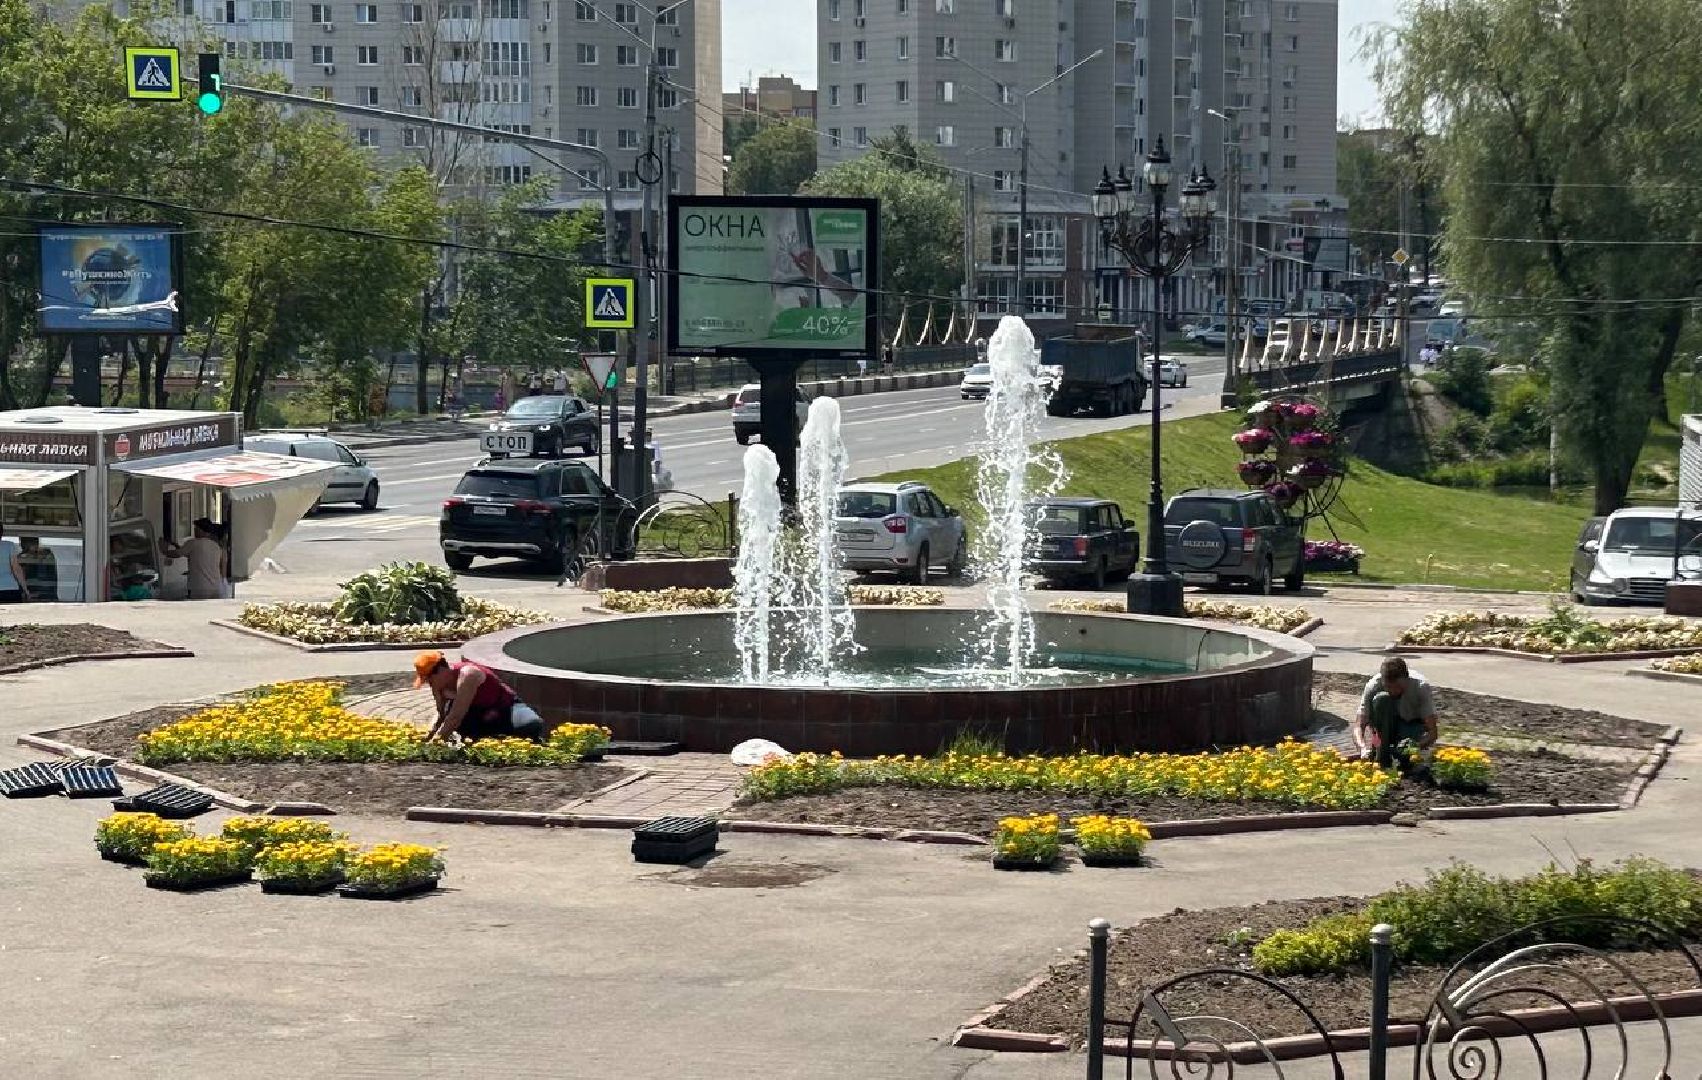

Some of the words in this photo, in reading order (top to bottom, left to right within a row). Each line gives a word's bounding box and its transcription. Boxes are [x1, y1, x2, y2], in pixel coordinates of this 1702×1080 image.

[685, 214, 765, 238] ОКНА
[802, 315, 849, 336] 40%
[39, 444, 88, 457] ЛАВКА
[486, 435, 527, 450] СТОП
